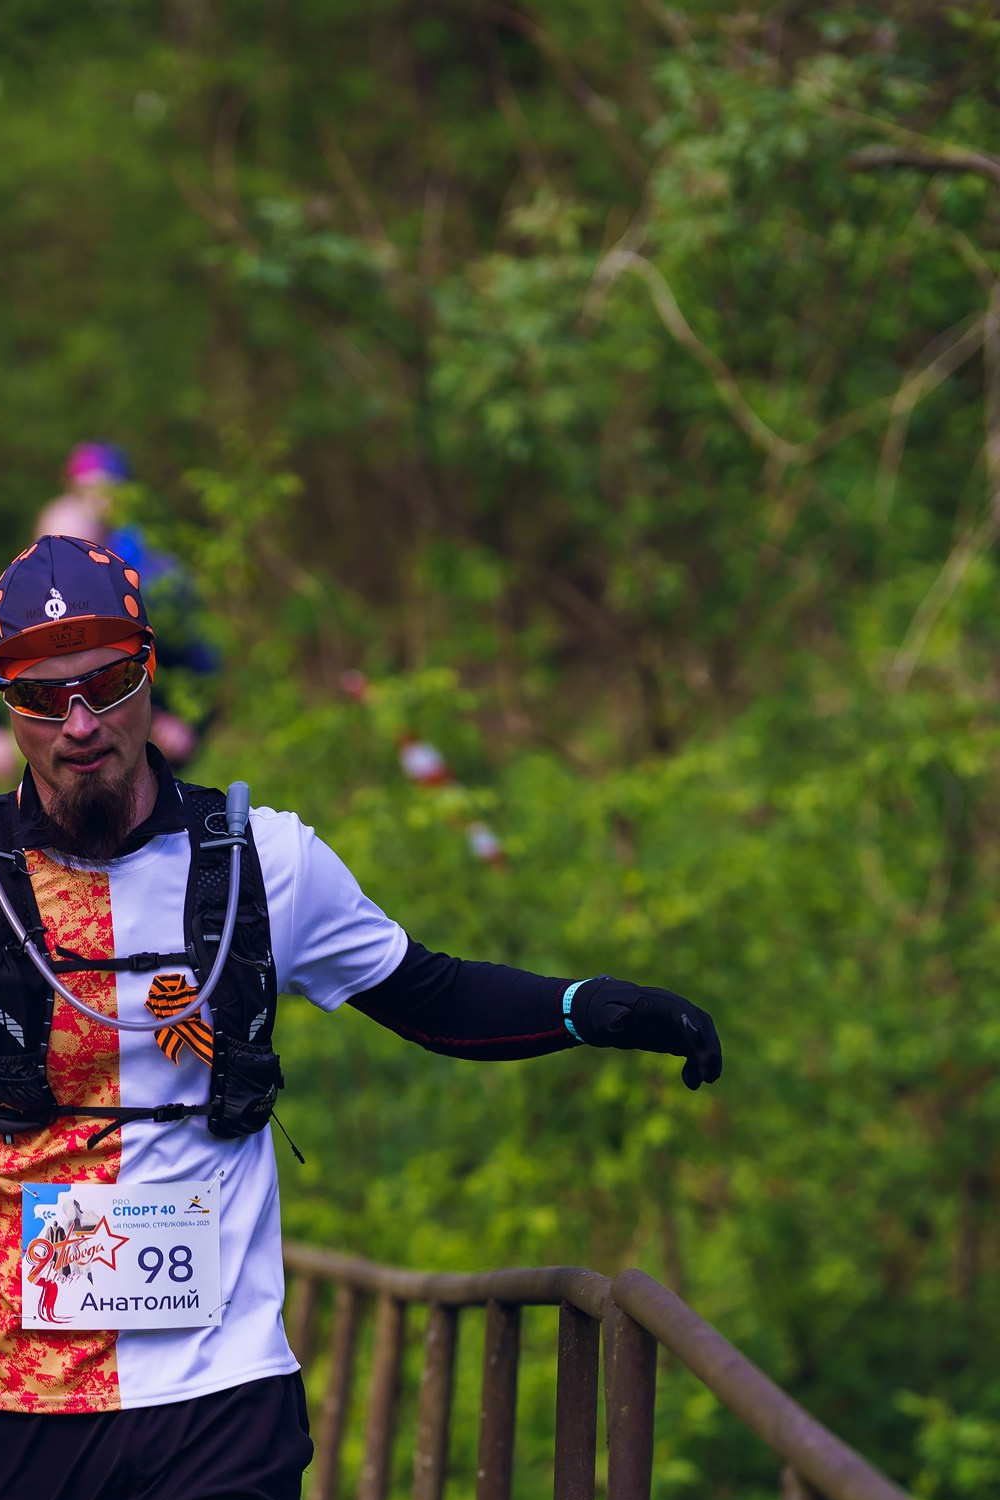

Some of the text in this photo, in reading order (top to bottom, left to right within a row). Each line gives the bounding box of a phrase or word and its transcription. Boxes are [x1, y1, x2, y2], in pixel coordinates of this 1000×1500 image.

[112, 1205, 158, 1216] СПОРТ
[160, 1204, 176, 1215] 40
[152, 1221, 196, 1229] СТРЕЛКОВКА»
[27, 1238, 55, 1283] 9
[137, 1245, 194, 1284] 98
[80, 1289, 200, 1312] Анатолий
